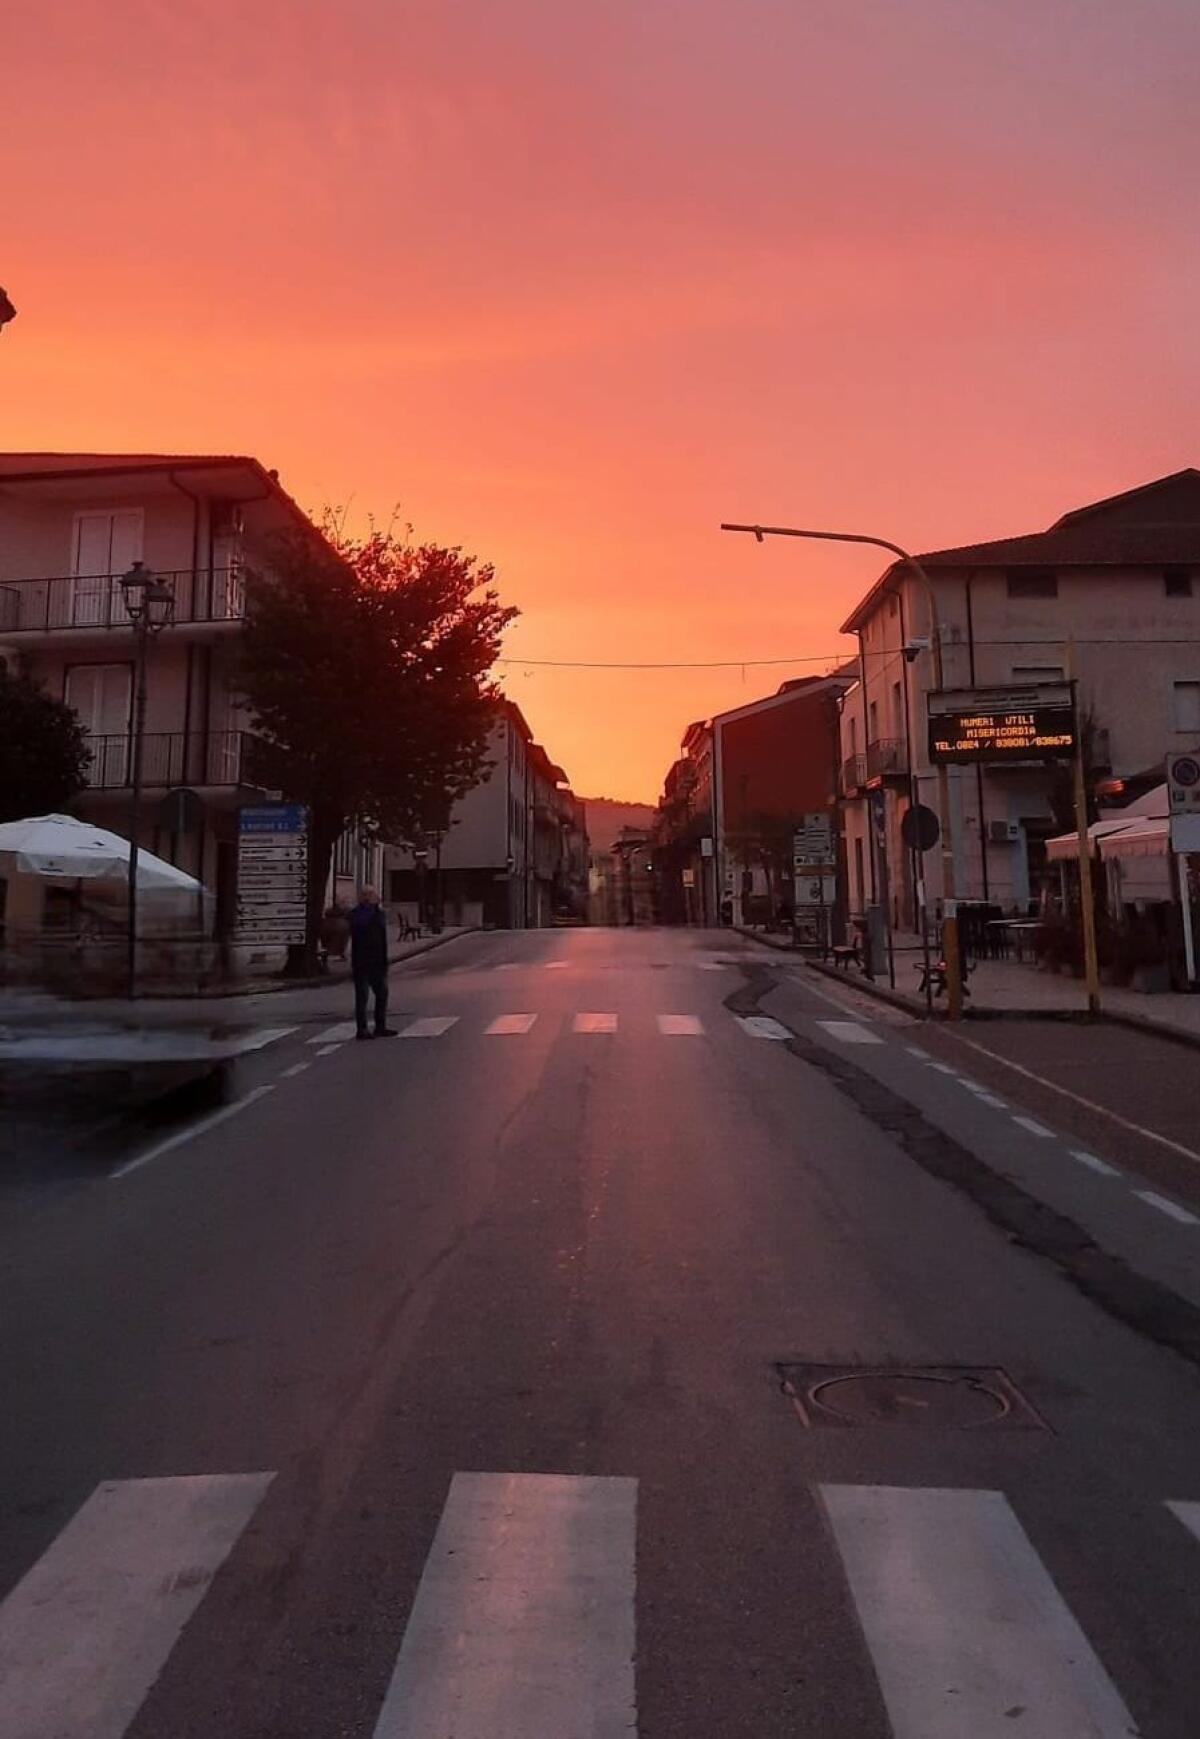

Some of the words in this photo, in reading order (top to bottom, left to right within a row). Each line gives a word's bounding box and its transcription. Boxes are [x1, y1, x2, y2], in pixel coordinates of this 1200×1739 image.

[960, 717, 994, 727] NUMERI
[1005, 715, 1035, 725] UTILI
[966, 727, 1036, 738] MISERICORDIA
